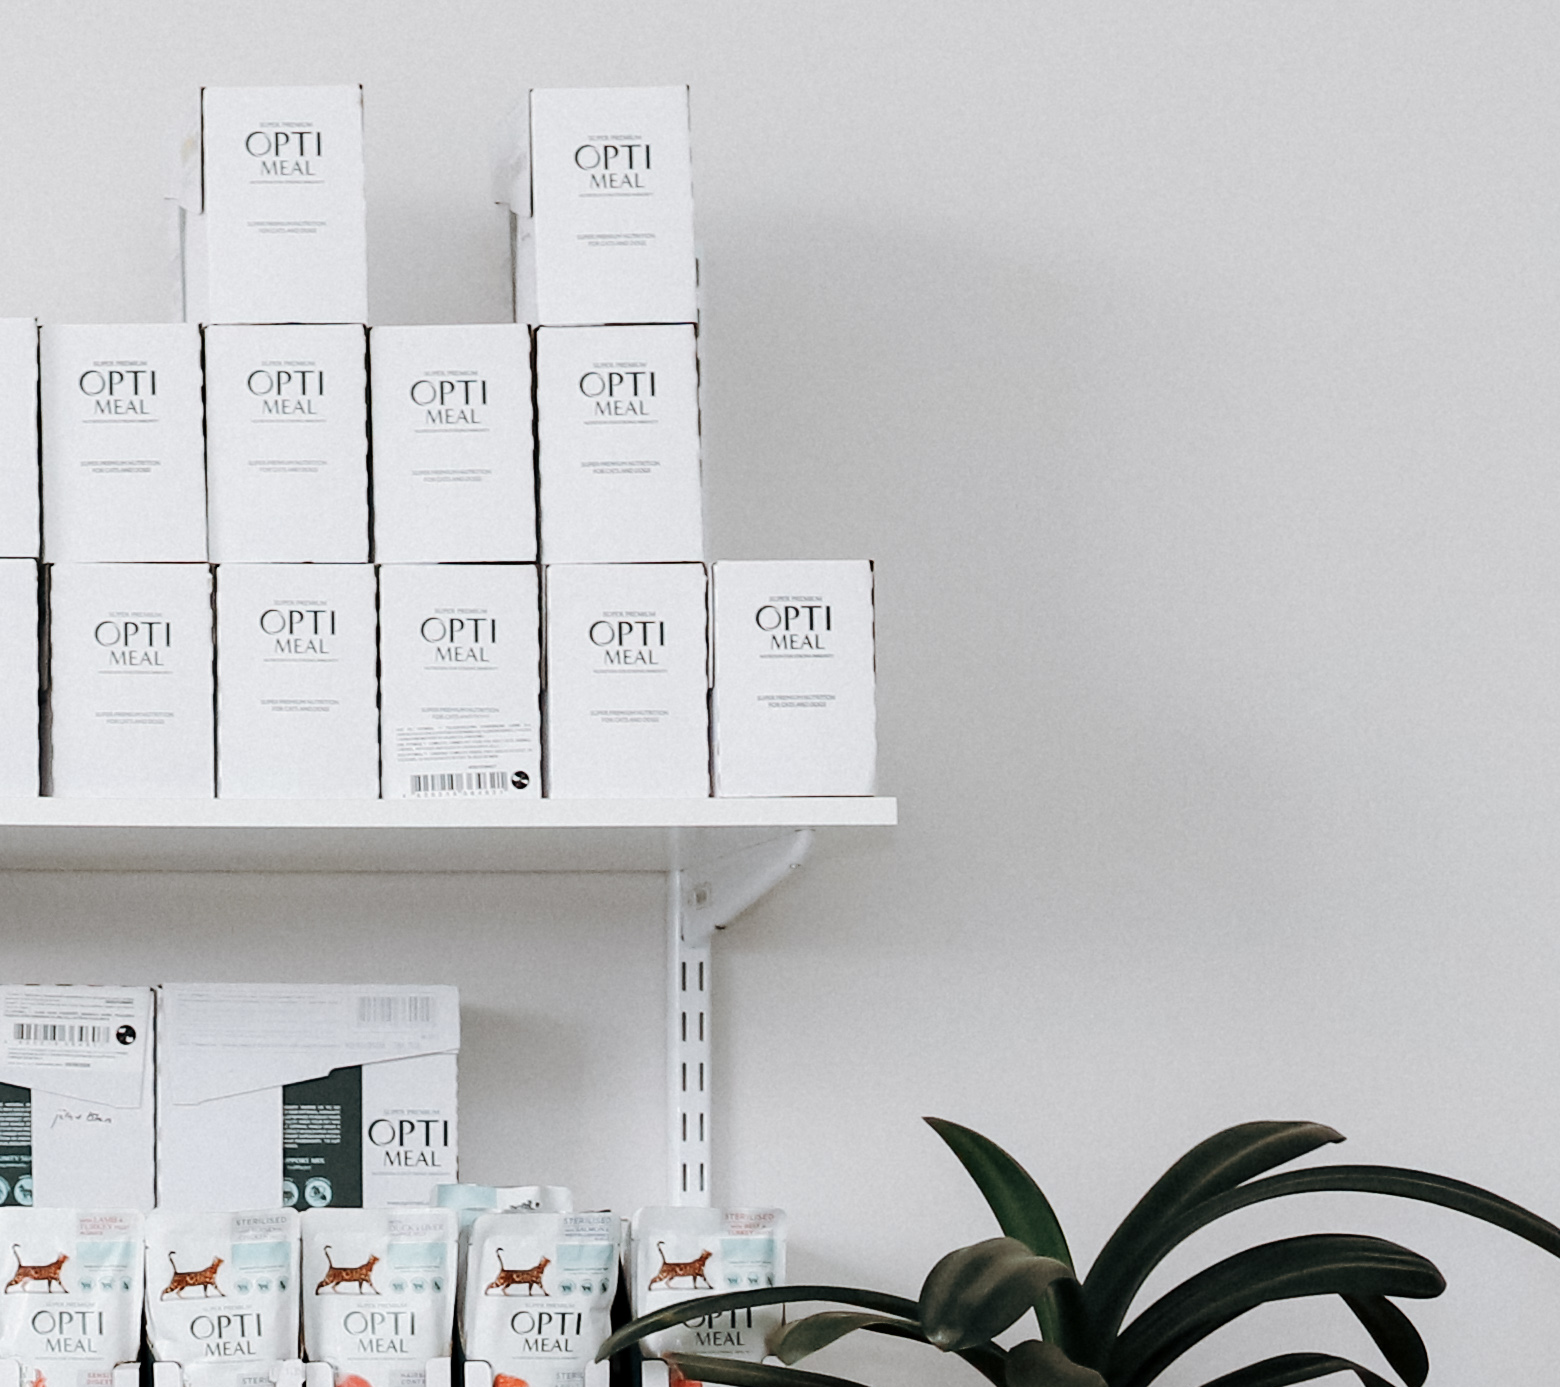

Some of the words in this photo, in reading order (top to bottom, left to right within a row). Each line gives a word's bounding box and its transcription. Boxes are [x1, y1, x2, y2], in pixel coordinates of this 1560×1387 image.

[245, 131, 322, 157] OPTI
[261, 159, 316, 176] MEAL
[574, 144, 651, 171] OPTI
[590, 172, 645, 189] MEAL
[79, 369, 156, 396] OPTI
[579, 371, 656, 398] OPTI
[95, 398, 150, 415] MEAL
[595, 399, 649, 416] MEAL
[259, 609, 336, 636] OPTI
[755, 605, 831, 632] OPTI
[274, 637, 330, 655] MEAL
[771, 633, 825, 650] MEAL
[367, 1118, 449, 1147] OPTI
[385, 1150, 441, 1167] MEAL
[510, 1310, 582, 1336] OPTI
[524, 1337, 574, 1353] MEAL
